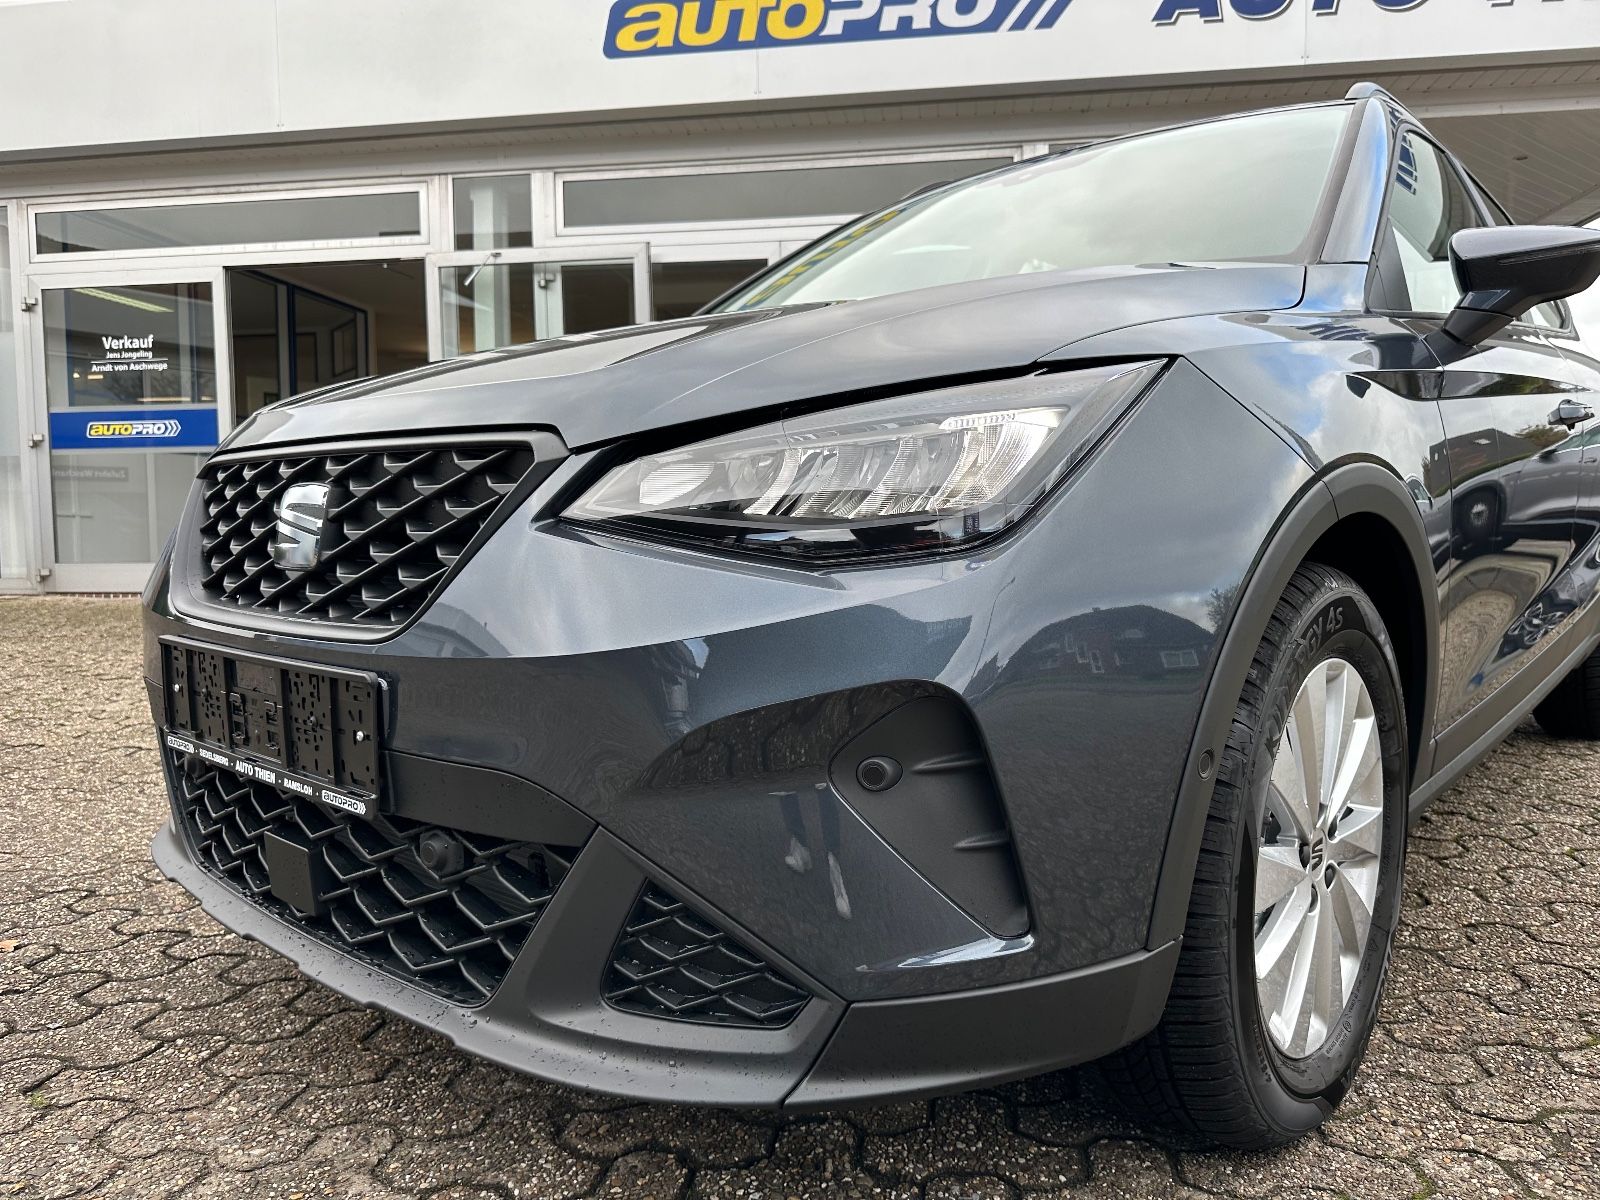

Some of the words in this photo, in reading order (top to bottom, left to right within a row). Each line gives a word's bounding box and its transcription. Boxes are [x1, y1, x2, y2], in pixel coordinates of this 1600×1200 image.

[102, 334, 154, 350] Verkauf
[106, 351, 121, 359] Jens
[121, 350, 153, 359] Jongeling
[91, 364, 113, 372] Arndt
[129, 362, 168, 371] Aschwege
[236, 760, 254, 776] AUTO
[254, 766, 276, 784] THIEN
[283, 778, 313, 796] RAMSLOH
